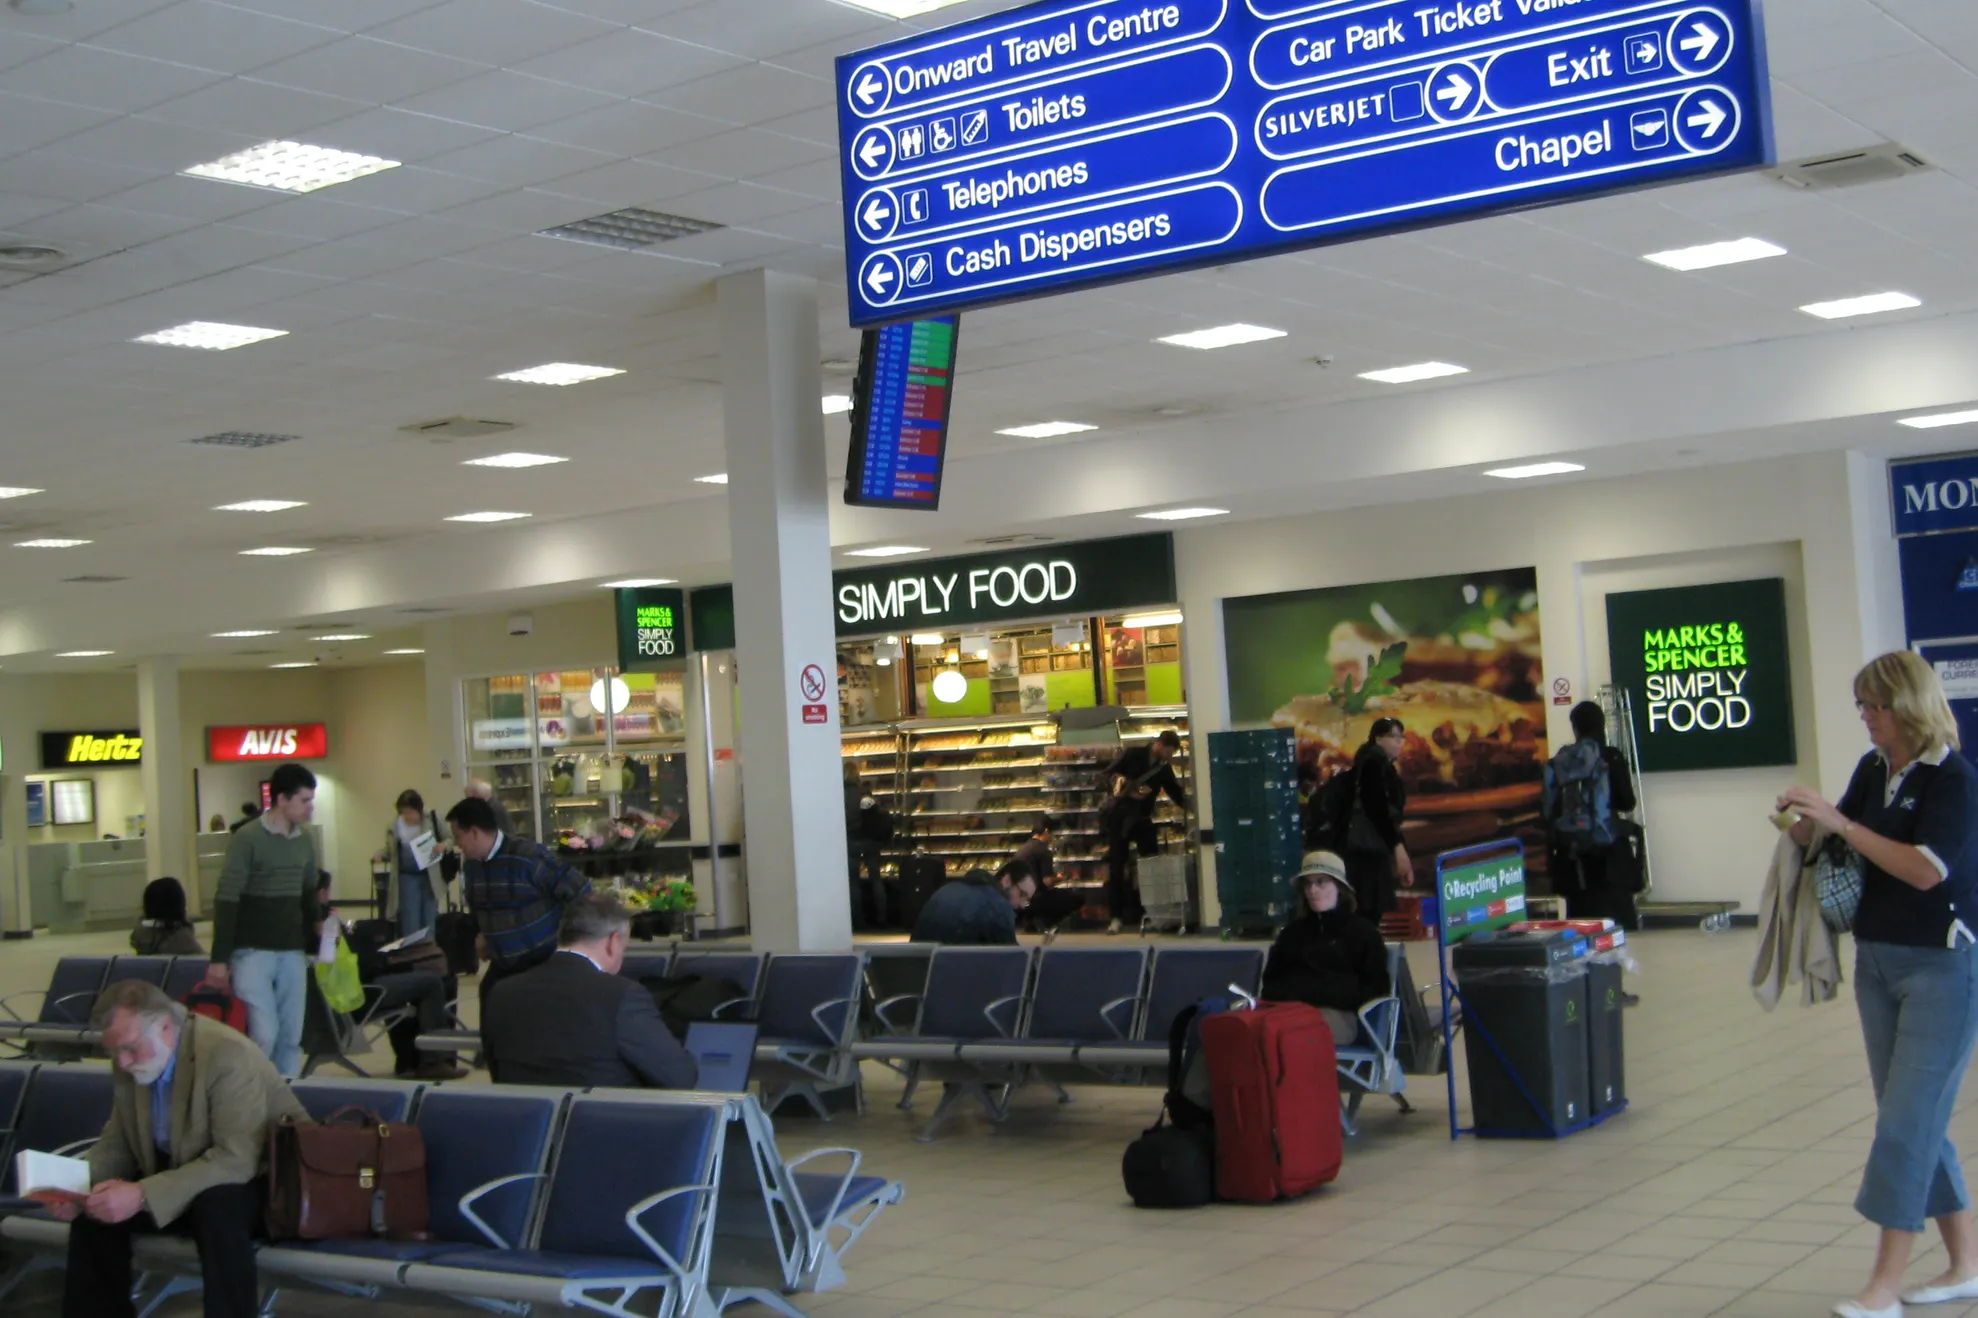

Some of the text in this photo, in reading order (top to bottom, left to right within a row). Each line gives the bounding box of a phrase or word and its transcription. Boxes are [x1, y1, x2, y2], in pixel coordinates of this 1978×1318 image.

[894, 3, 1181, 96] Onward Travel Centre
[1288, 37, 1337, 67] Car
[1344, 19, 1404, 54] Park
[1414, 0, 1504, 39] Ticket
[1546, 47, 1613, 87] Exit
[1001, 91, 1088, 133] Toilets
[1264, 94, 1386, 139] SILVERJET
[1494, 119, 1612, 173] Chapel
[941, 159, 1090, 212] Telephones
[945, 212, 1172, 279] Cash Dispensers
[838, 560, 1076, 624] SIMPLY FOOD
[637, 607, 672, 617] MARKS &
[637, 617, 673, 628] SPENCER
[637, 628, 673, 641] SIMPLY
[638, 640, 674, 655] FOOD
[1643, 622, 1744, 651] MARKS &
[1644, 644, 1748, 673] SPENCER
[1645, 669, 1748, 701] SIMPLY
[1648, 696, 1751, 734] FOOD
[68, 733, 143, 763] Hertz
[239, 728, 298, 756] AVIS
[1454, 866, 1522, 899] Recycling Point
